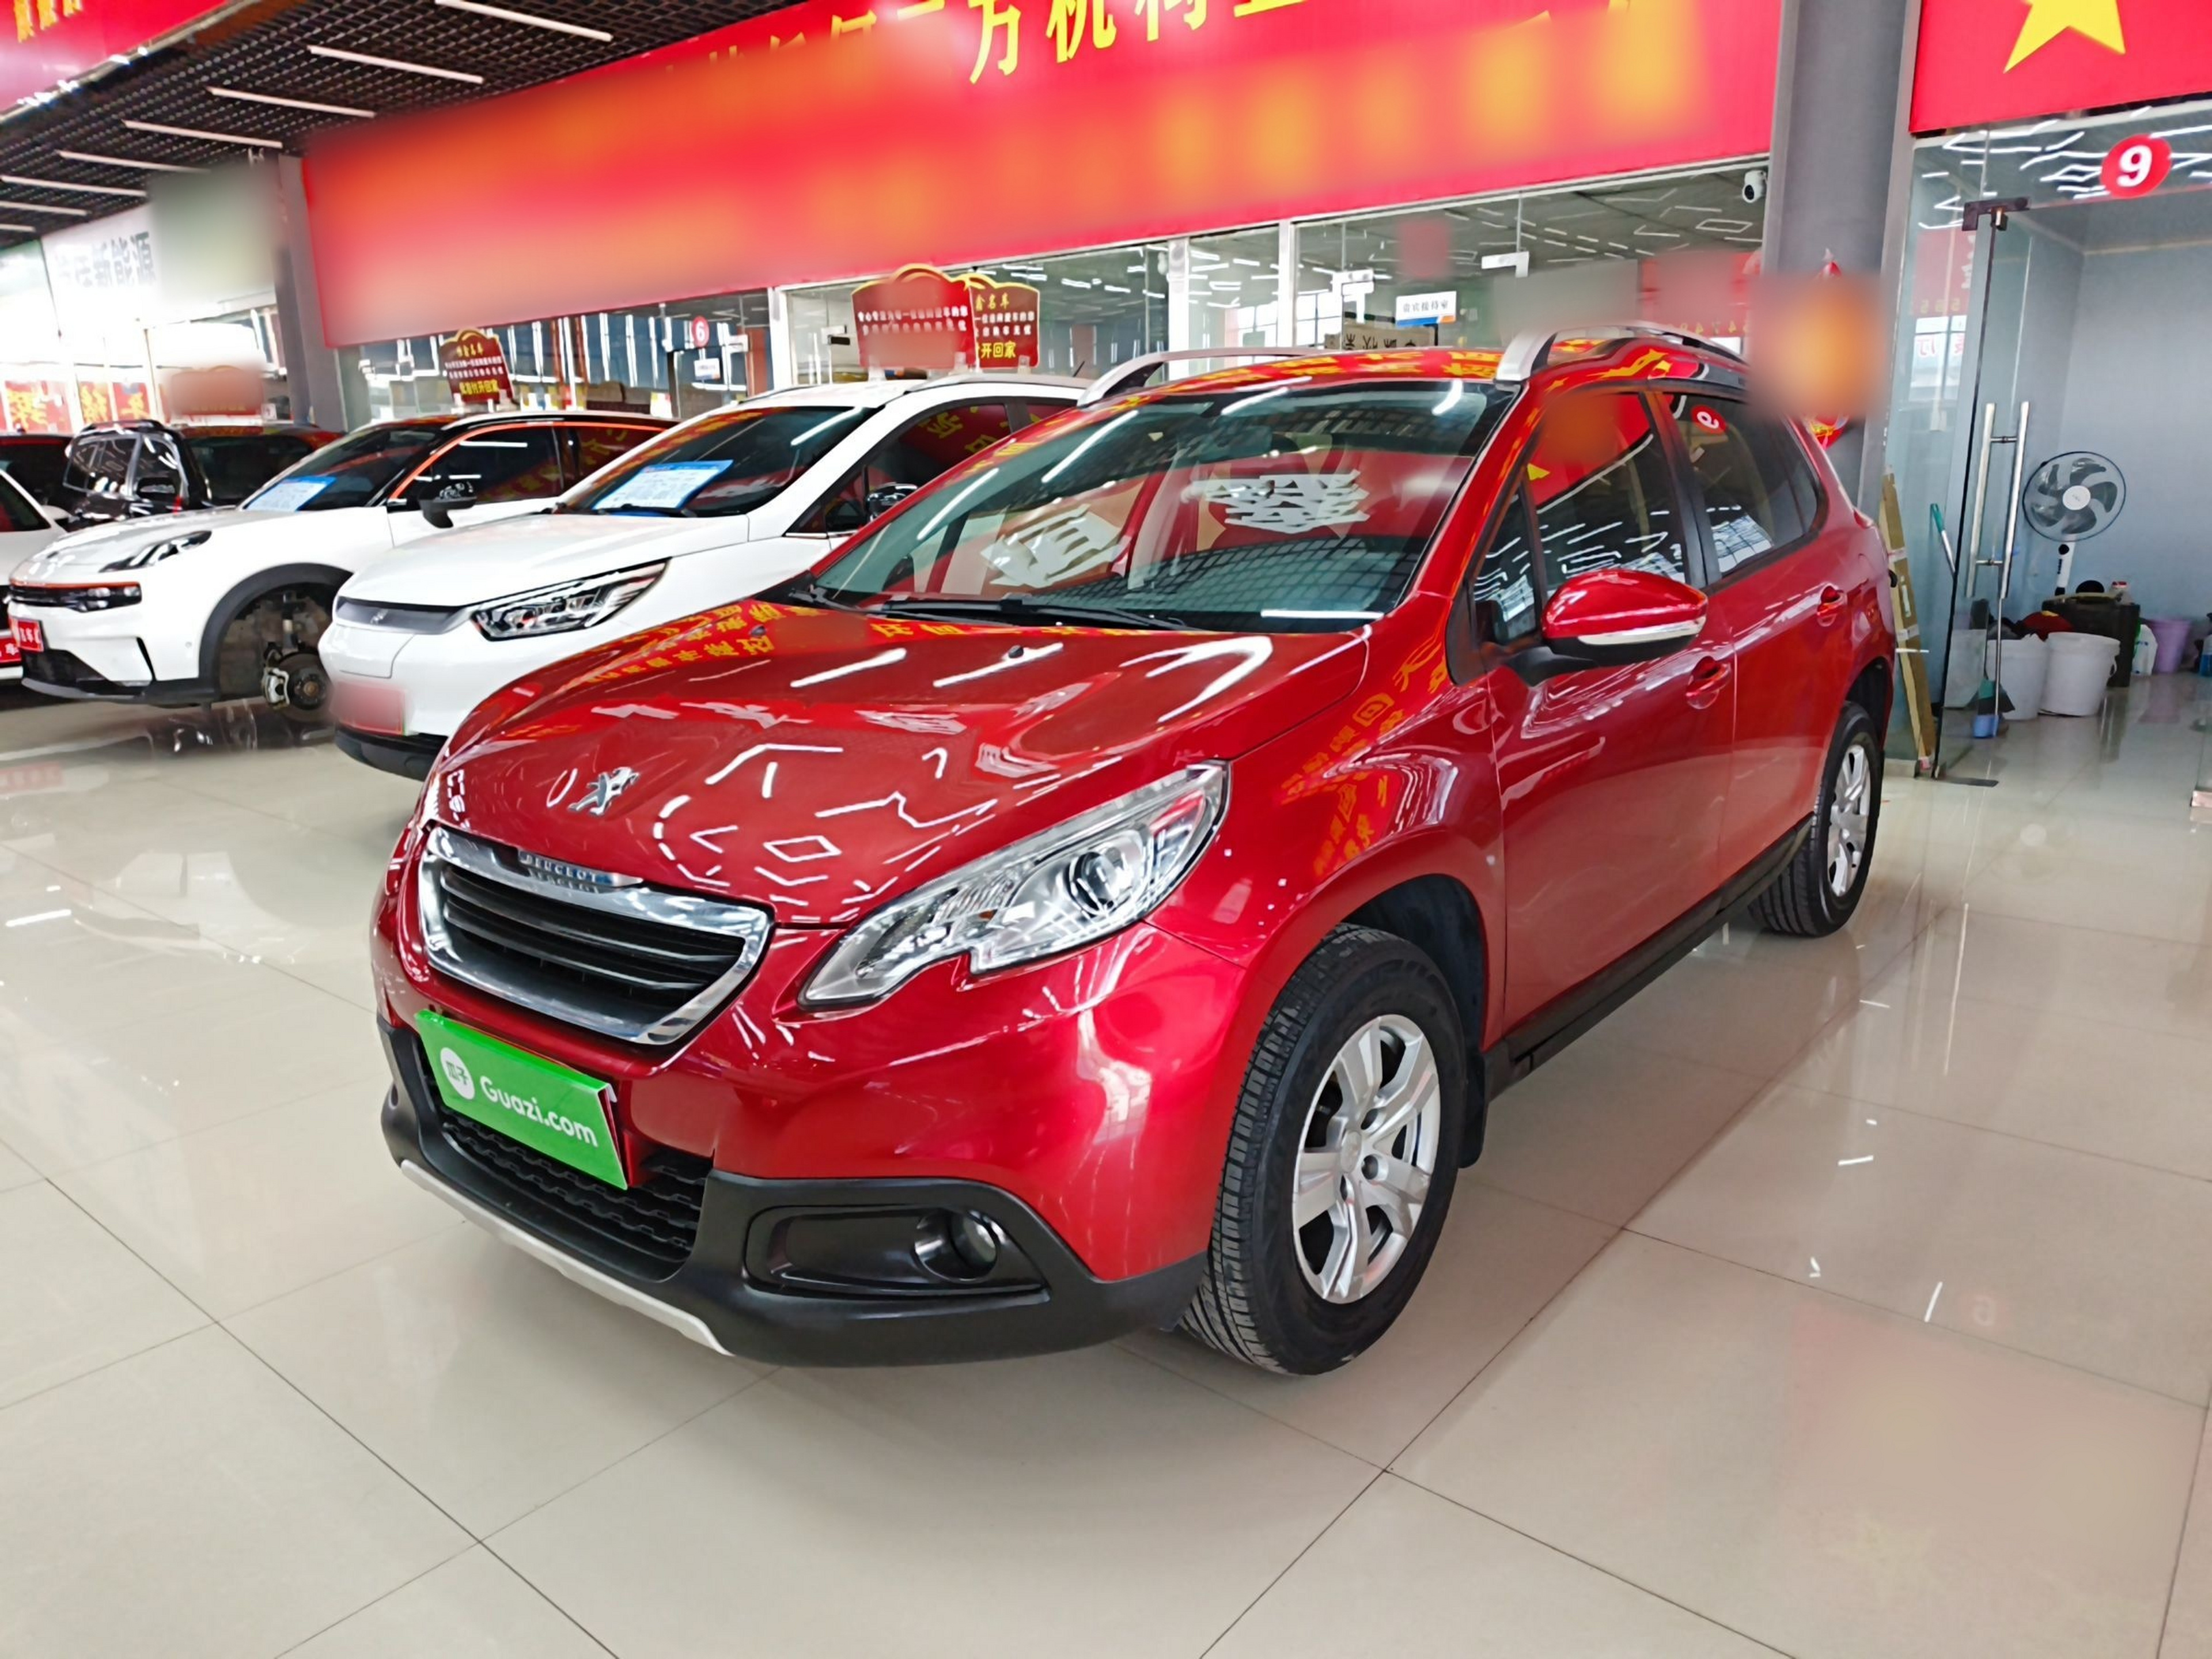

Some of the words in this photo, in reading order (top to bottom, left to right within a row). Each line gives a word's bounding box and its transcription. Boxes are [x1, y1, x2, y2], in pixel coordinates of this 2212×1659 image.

[2116, 145, 2153, 187] 9
[696, 321, 706, 342] 6
[521, 854, 597, 883] PEUGEOT
[480, 1075, 598, 1147] Guazi.com
